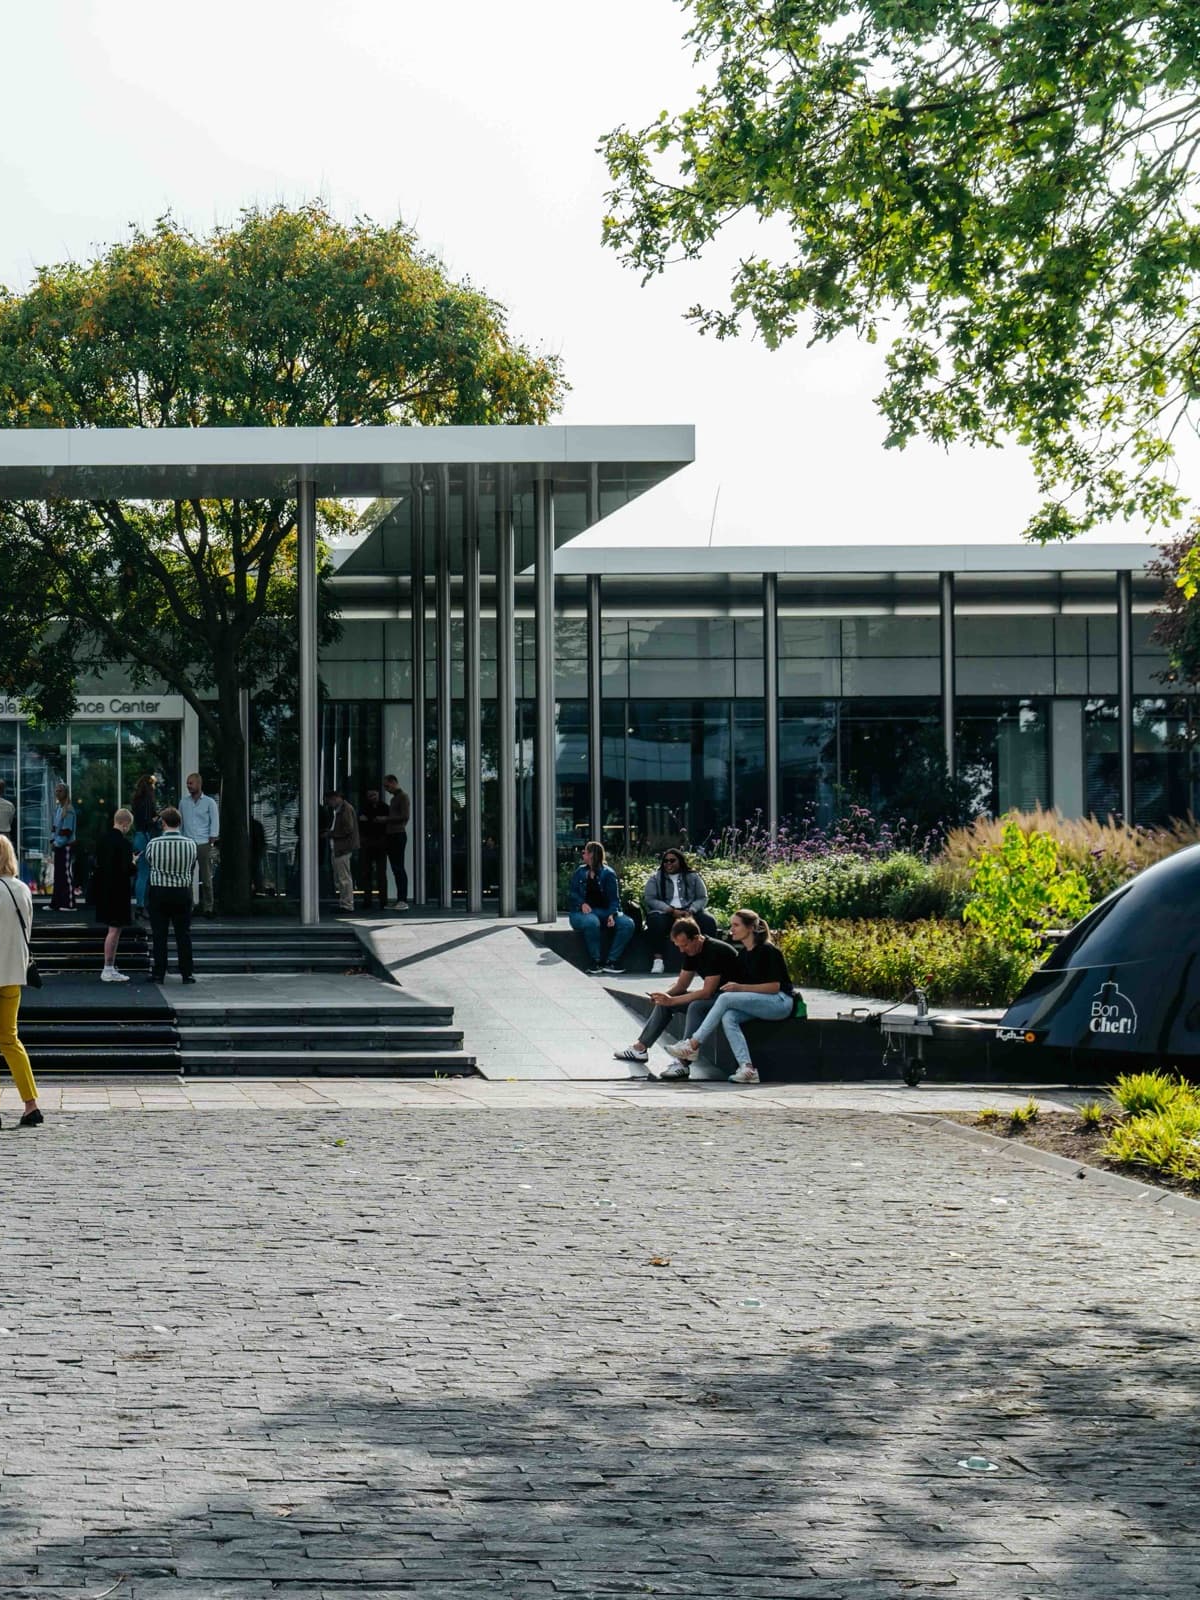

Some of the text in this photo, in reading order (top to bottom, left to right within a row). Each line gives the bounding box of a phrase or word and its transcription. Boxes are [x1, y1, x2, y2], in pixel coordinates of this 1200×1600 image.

[109, 699, 160, 713] Center
[1091, 1001, 1119, 1017] Bon
[1089, 1017, 1132, 1033] Chef!
